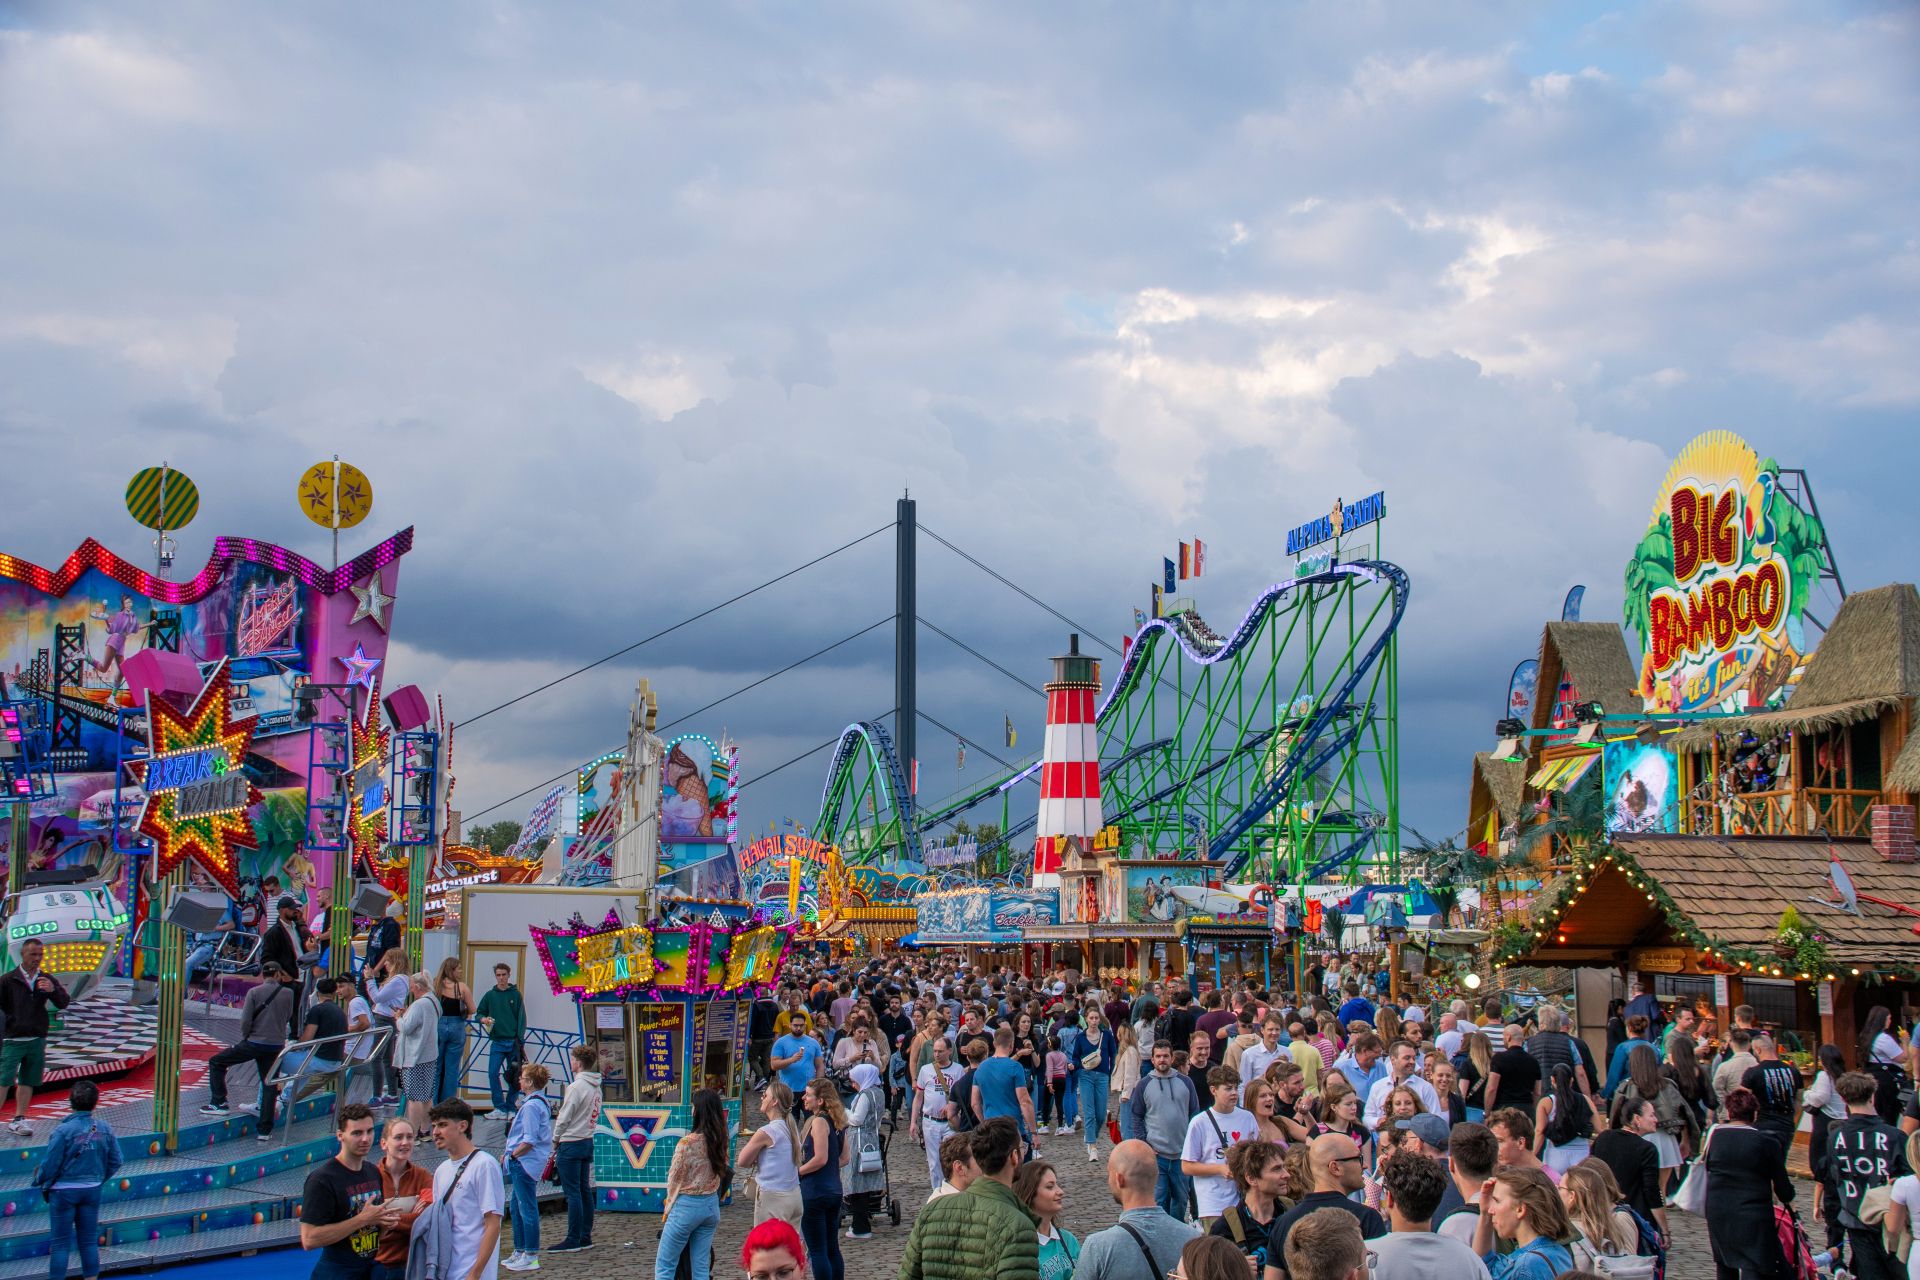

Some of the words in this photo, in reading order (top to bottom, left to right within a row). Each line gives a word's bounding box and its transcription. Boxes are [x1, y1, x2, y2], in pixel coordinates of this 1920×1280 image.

[1286, 514, 1332, 555] ALPINA
[1343, 491, 1384, 533] BAHN
[1671, 486, 1737, 582] BIG
[1650, 560, 1786, 673] BAMBOO
[1688, 672, 1711, 704] it's
[1714, 649, 1748, 698] fun!
[148, 752, 214, 791] BREAK
[182, 776, 247, 814] DANCE
[739, 835, 782, 871] HAWAII
[785, 834, 831, 865] SWIN
[425, 869, 498, 894] ratwurst
[44, 892, 77, 907] 18
[1217, 912, 1268, 925] KASSE
[590, 953, 648, 987] DANCE
[639, 1015, 680, 1031] Power-Tarife
[1216, 1147, 1225, 1159] S
[1835, 1131, 1889, 1150] AIR
[1837, 1155, 1890, 1176] JOR
